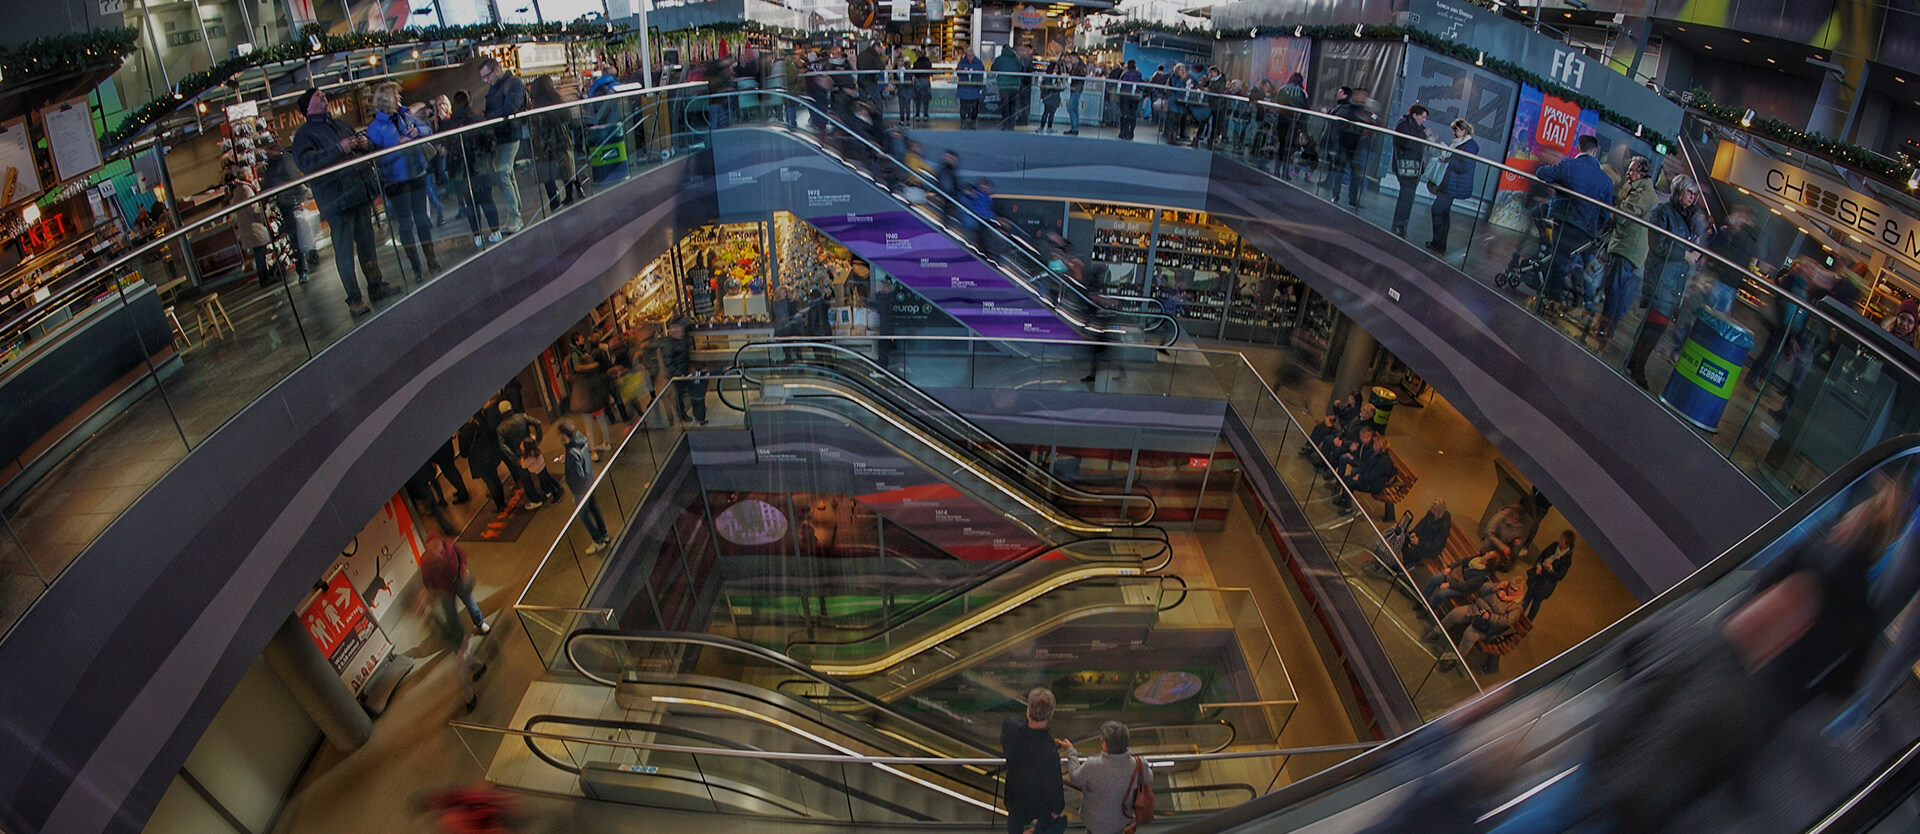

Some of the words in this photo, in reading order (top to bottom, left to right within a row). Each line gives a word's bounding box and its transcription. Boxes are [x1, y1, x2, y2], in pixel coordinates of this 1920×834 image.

[1543, 105, 1576, 128] MARKT
[1542, 121, 1570, 147] HAL
[102, 183, 114, 193] 112
[885, 232, 899, 240] 1940
[1882, 219, 1901, 246] &
